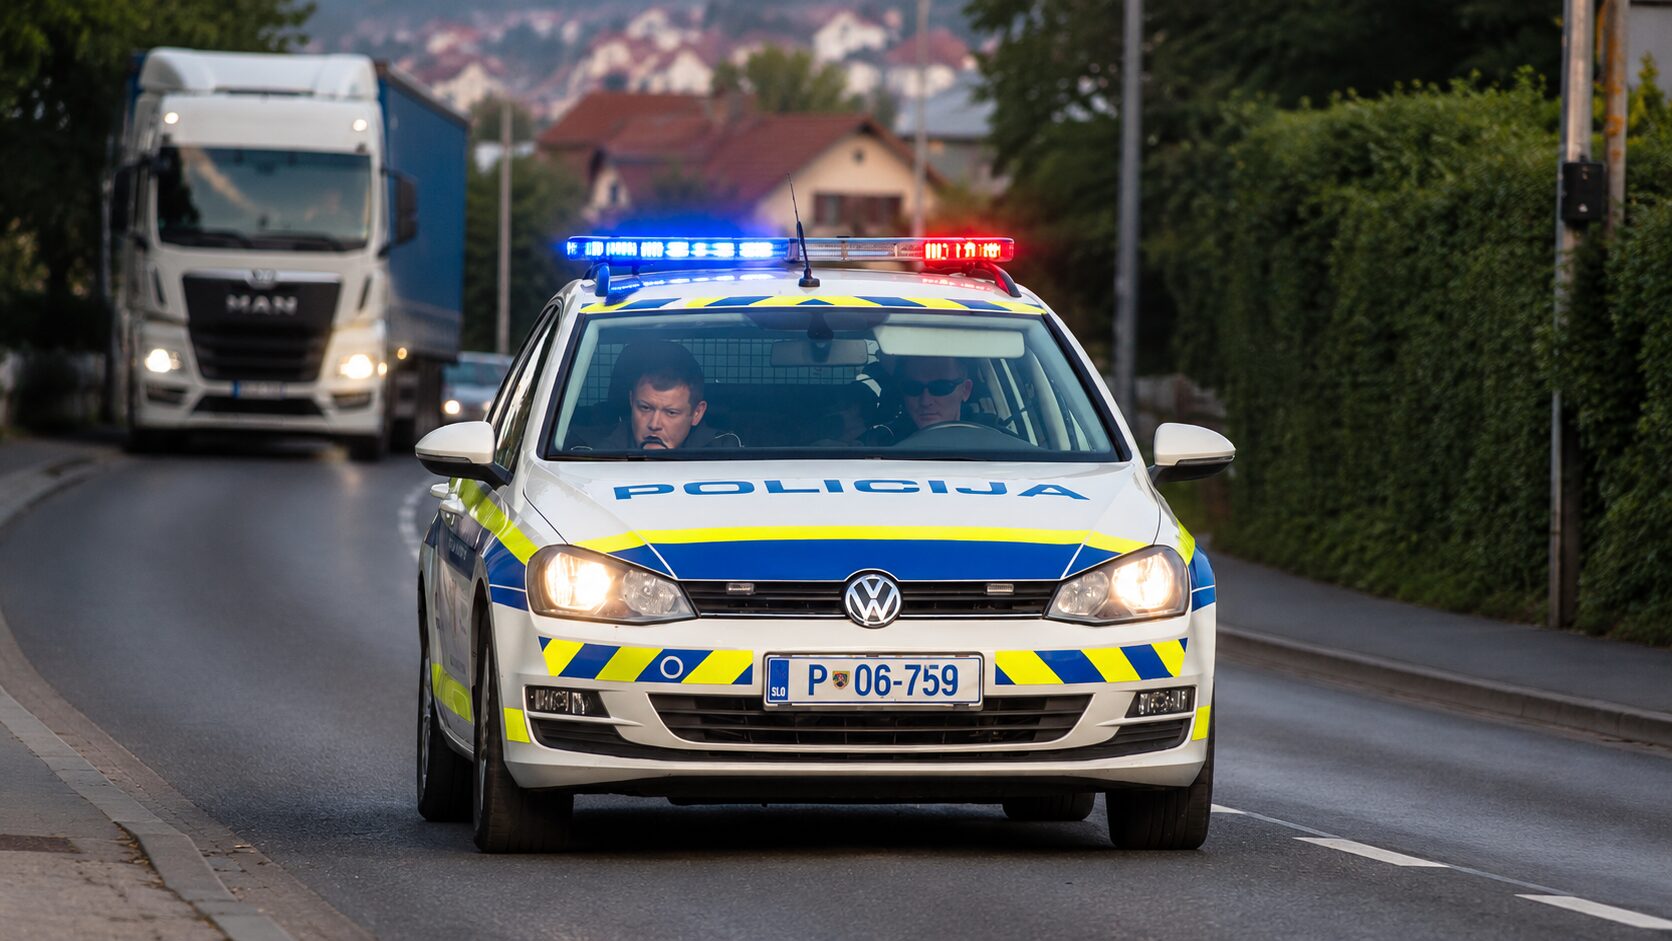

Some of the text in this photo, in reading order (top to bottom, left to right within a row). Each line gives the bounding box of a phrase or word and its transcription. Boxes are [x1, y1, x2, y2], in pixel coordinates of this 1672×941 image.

[226, 294, 298, 315] MAN
[613, 479, 1091, 500] POLICIJA
[808, 664, 958, 697] P 06-759
[771, 686, 786, 697] SLO
